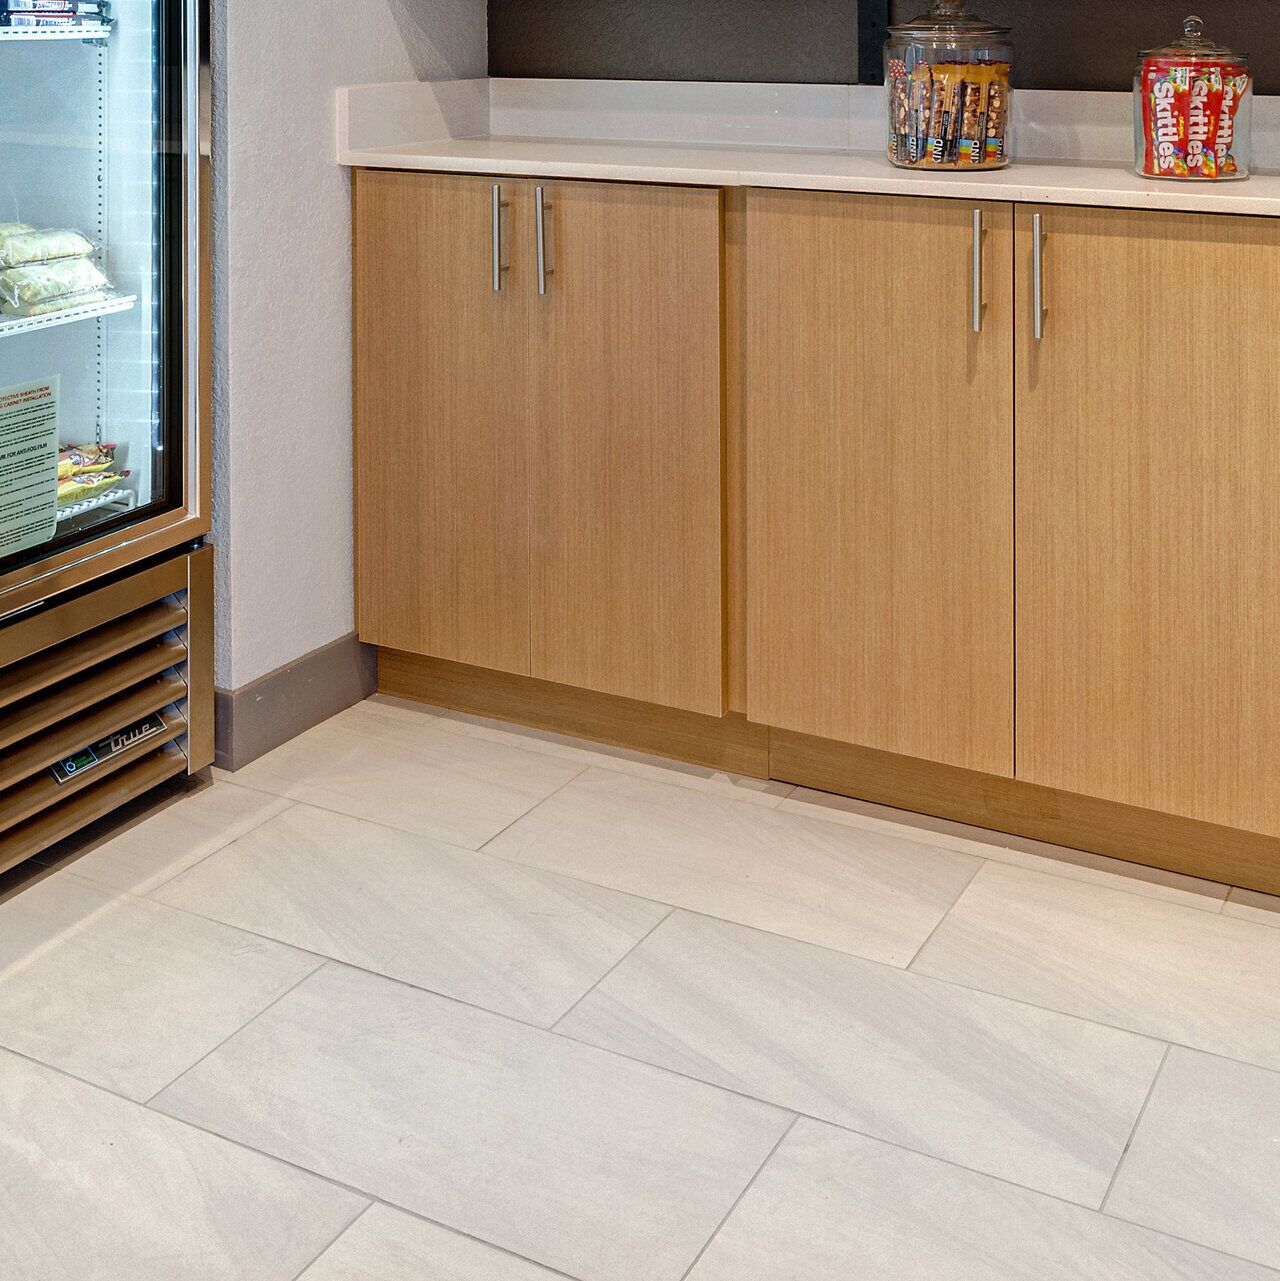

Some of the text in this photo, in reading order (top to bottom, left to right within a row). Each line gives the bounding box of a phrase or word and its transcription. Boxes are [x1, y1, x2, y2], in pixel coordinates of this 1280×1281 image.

[1153, 81, 1180, 170] Skittles
[1187, 80, 1210, 168] Skittles
[932, 138, 944, 162] KIND
[3, 399, 22, 409] CABINET
[23, 392, 52, 403] INSTALLATION
[19, 389, 37, 398] SHEATH
[6, 451, 16, 459] FOR
[98, 723, 157, 752] true
